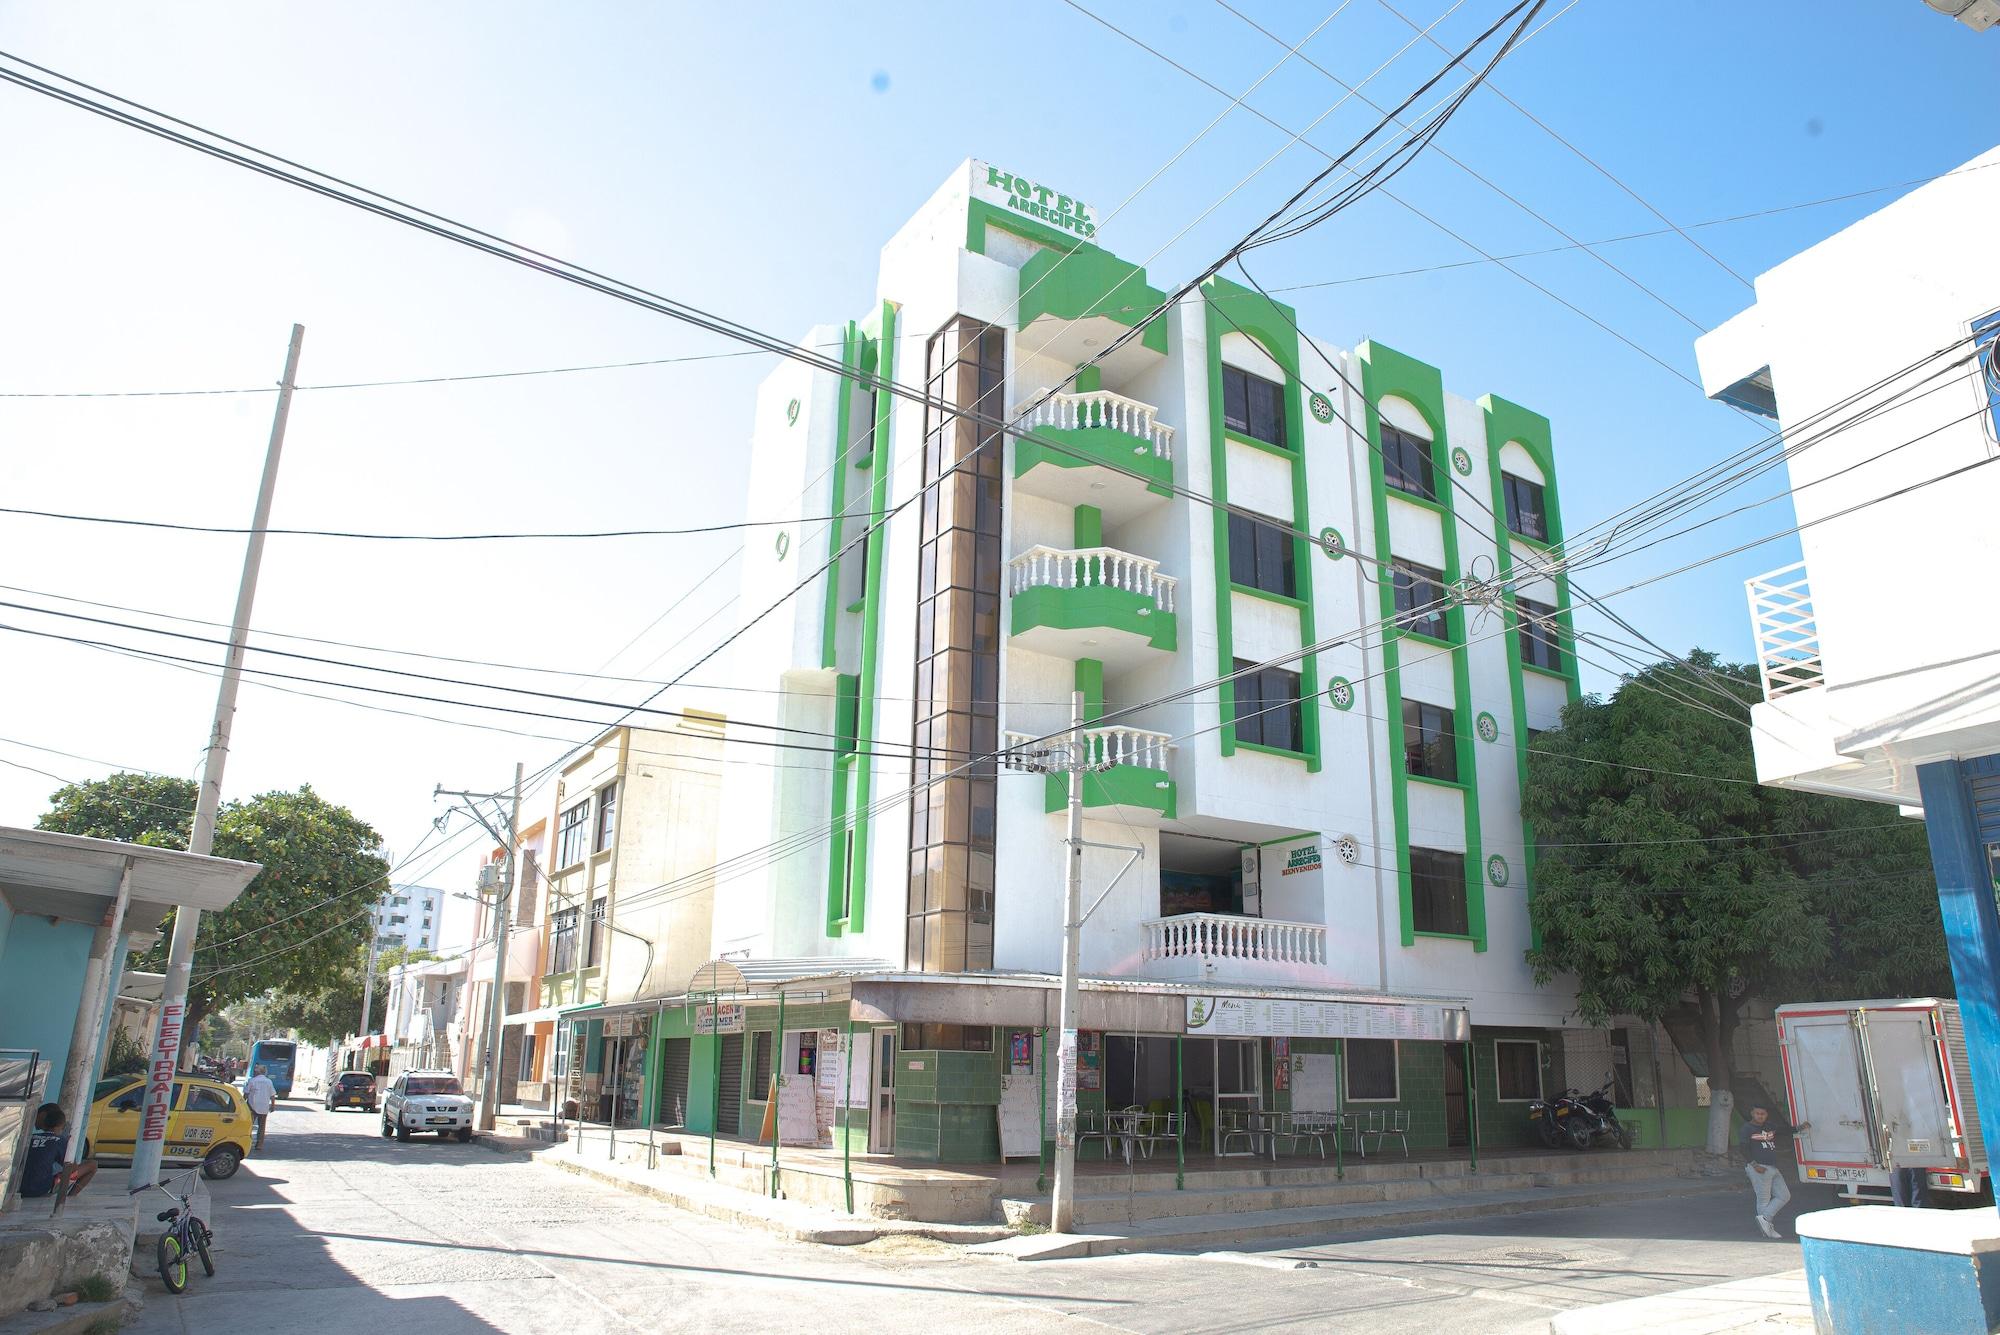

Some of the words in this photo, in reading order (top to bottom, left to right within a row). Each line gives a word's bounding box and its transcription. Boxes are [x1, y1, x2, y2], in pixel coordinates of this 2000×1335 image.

[987, 167, 1090, 221] HOTEL
[1008, 195, 1096, 238] ARRECIFES
[1291, 846, 1317, 858] HOTEL
[1287, 855, 1321, 868] ARRECIFES
[1282, 863, 1322, 876] BIENVENIDOS
[706, 1004, 733, 1016] ALACEN
[142, 1005, 183, 1141] ELECTROAIRES
[170, 1146, 200, 1157] 0945
